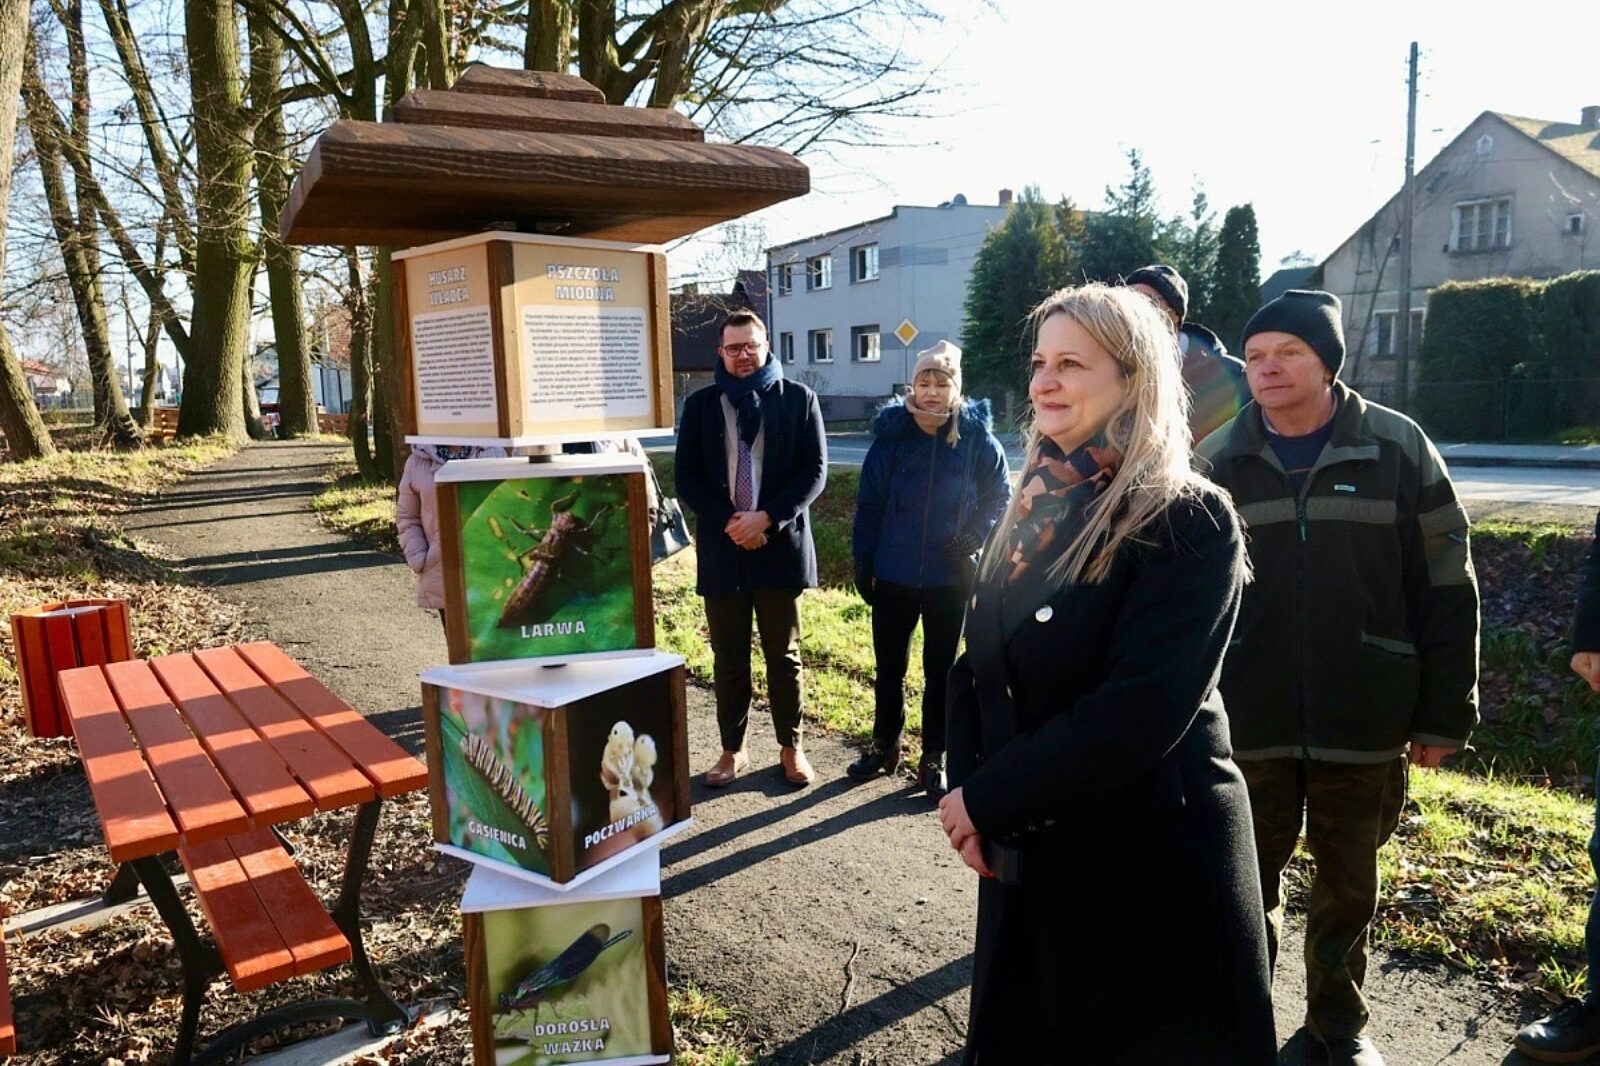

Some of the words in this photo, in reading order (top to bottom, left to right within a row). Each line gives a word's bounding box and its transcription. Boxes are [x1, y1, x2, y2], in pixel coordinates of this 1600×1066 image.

[556, 286, 614, 301] MIODNA
[520, 620, 586, 639] LARWA
[583, 804, 657, 850] POCZWARKA
